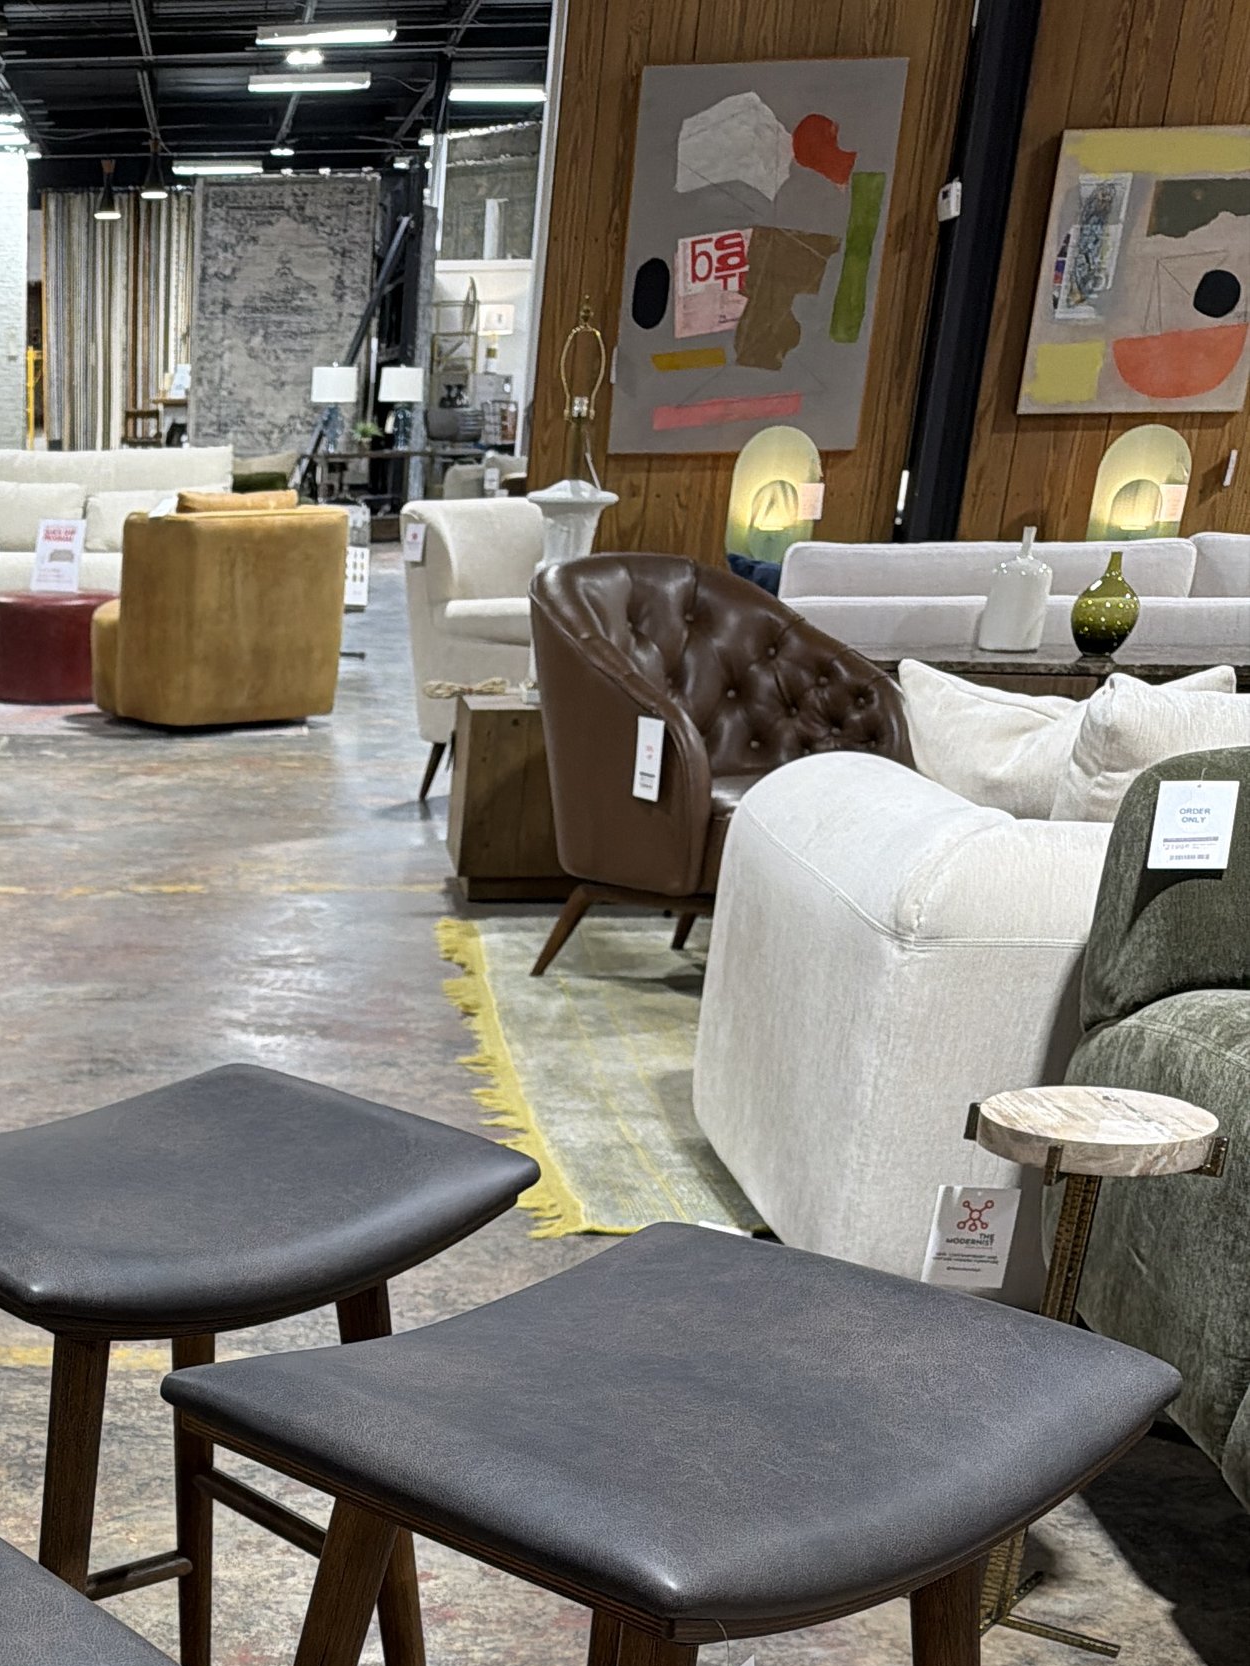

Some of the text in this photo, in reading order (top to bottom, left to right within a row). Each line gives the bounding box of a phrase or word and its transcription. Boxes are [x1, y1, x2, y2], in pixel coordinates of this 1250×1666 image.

[1179, 807, 1211, 815] ORDER
[1181, 816, 1206, 824] ONLY
[979, 1233, 995, 1241] THE
[945, 1237, 994, 1247] MODERNIST
